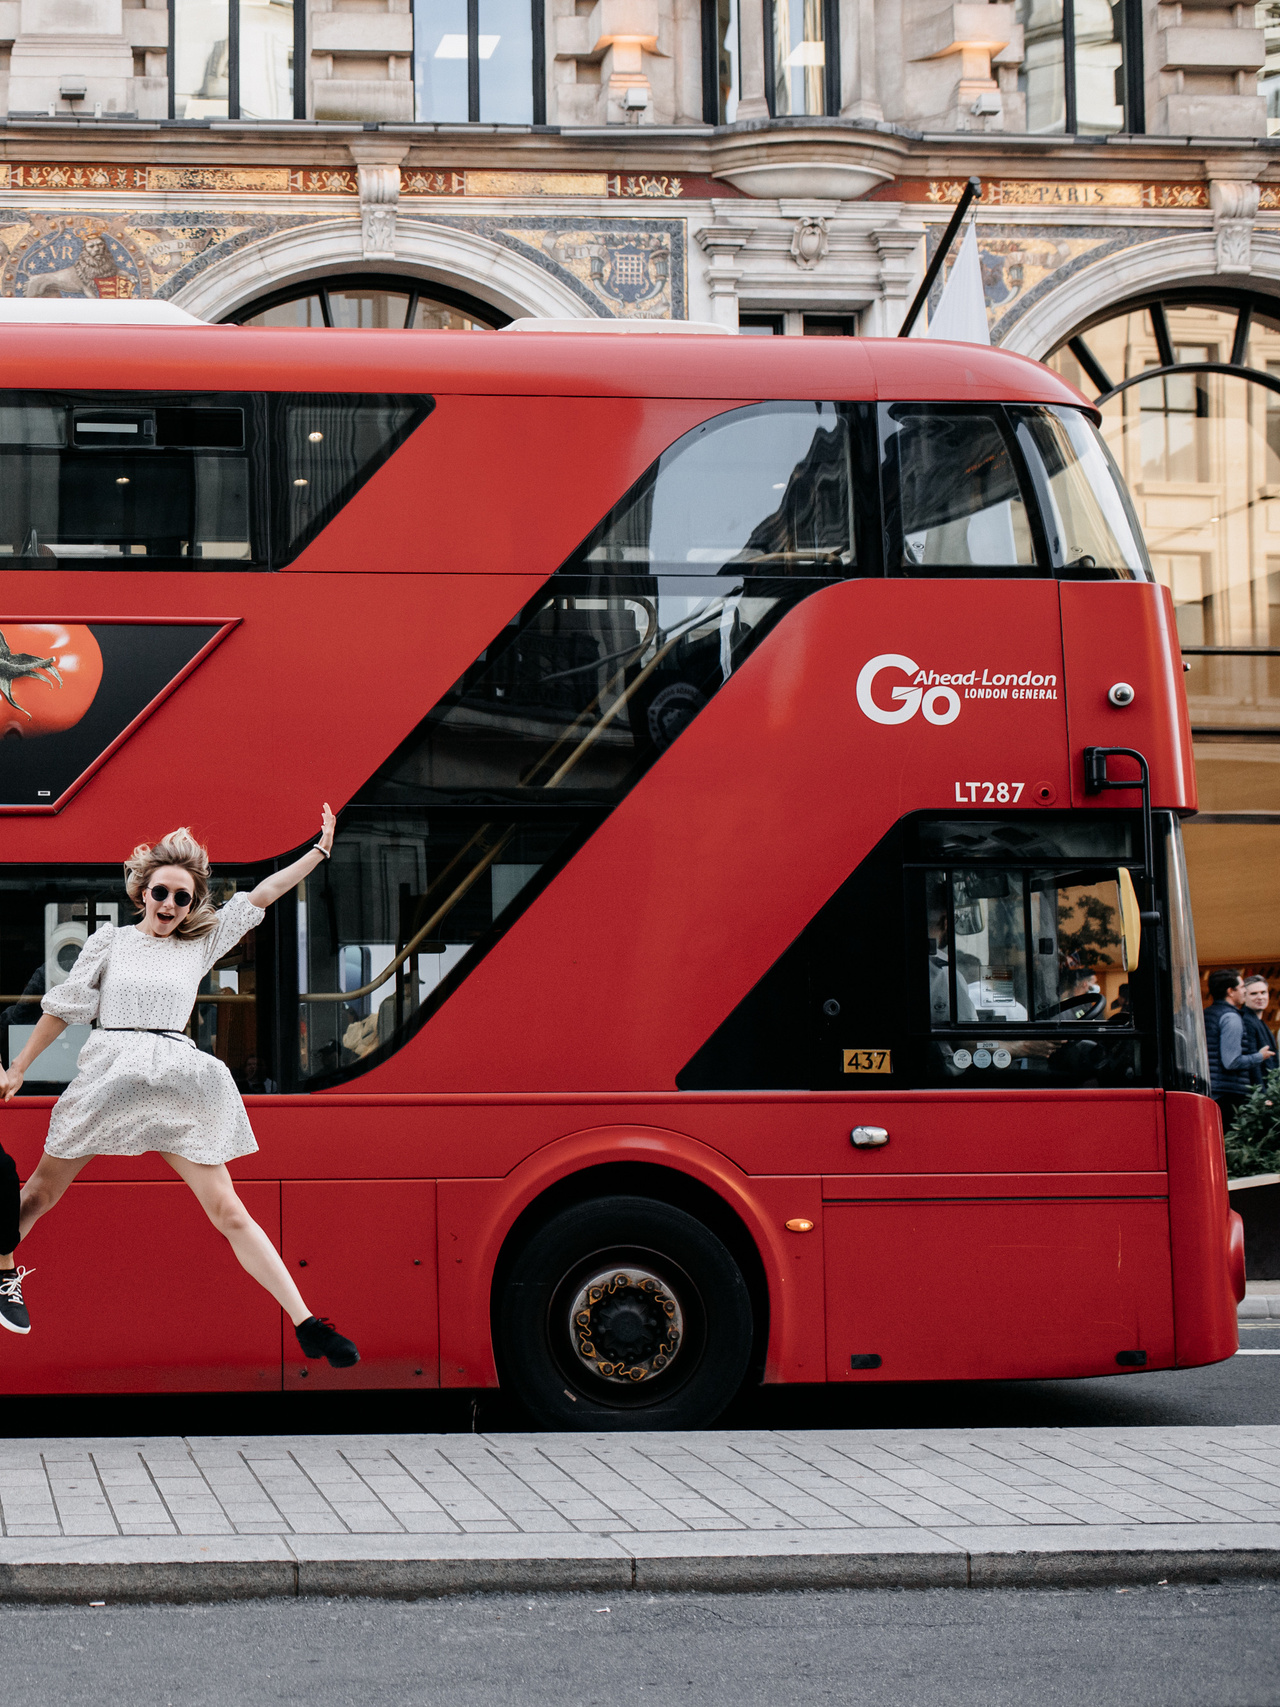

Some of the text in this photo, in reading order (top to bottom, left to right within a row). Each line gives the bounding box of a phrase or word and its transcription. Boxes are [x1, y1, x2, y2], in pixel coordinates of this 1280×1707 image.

[1038, 187, 1104, 201] PARIS
[49, 245, 73, 260] VR
[149, 244, 171, 257] MON
[856, 654, 1057, 725] Go Ahead-London
[964, 688, 1058, 700] LONDON GENERAL
[955, 782, 1025, 803] LT287
[847, 1051, 887, 1070] 437
